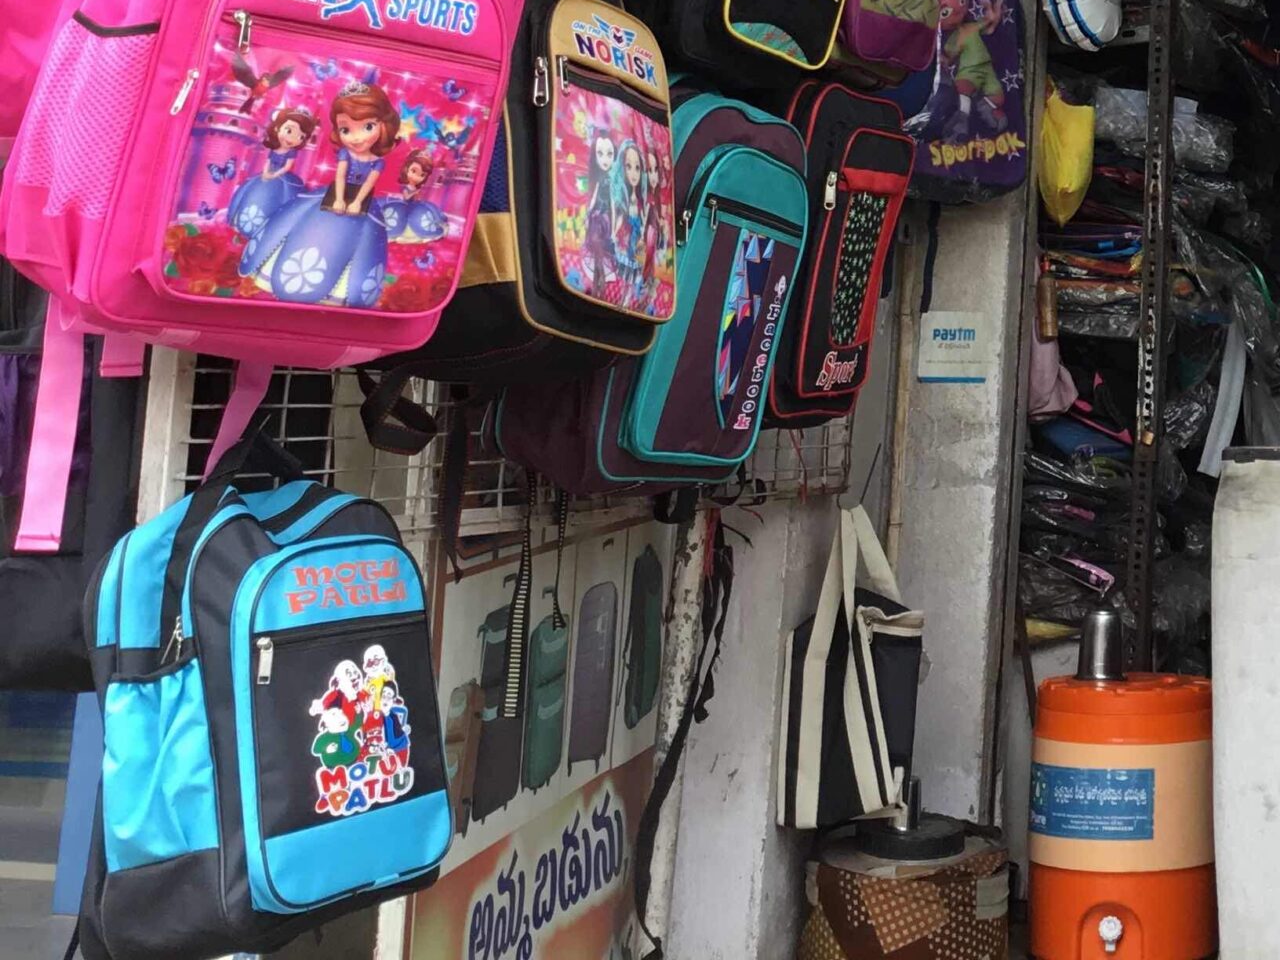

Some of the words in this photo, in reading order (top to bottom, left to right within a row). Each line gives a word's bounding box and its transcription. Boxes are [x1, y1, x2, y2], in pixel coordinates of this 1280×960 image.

[575, 32, 657, 86] NORISK
[933, 327, 976, 341] Paytm
[320, 755, 397, 793] MOTU
[328, 771, 410, 812] PATLU
